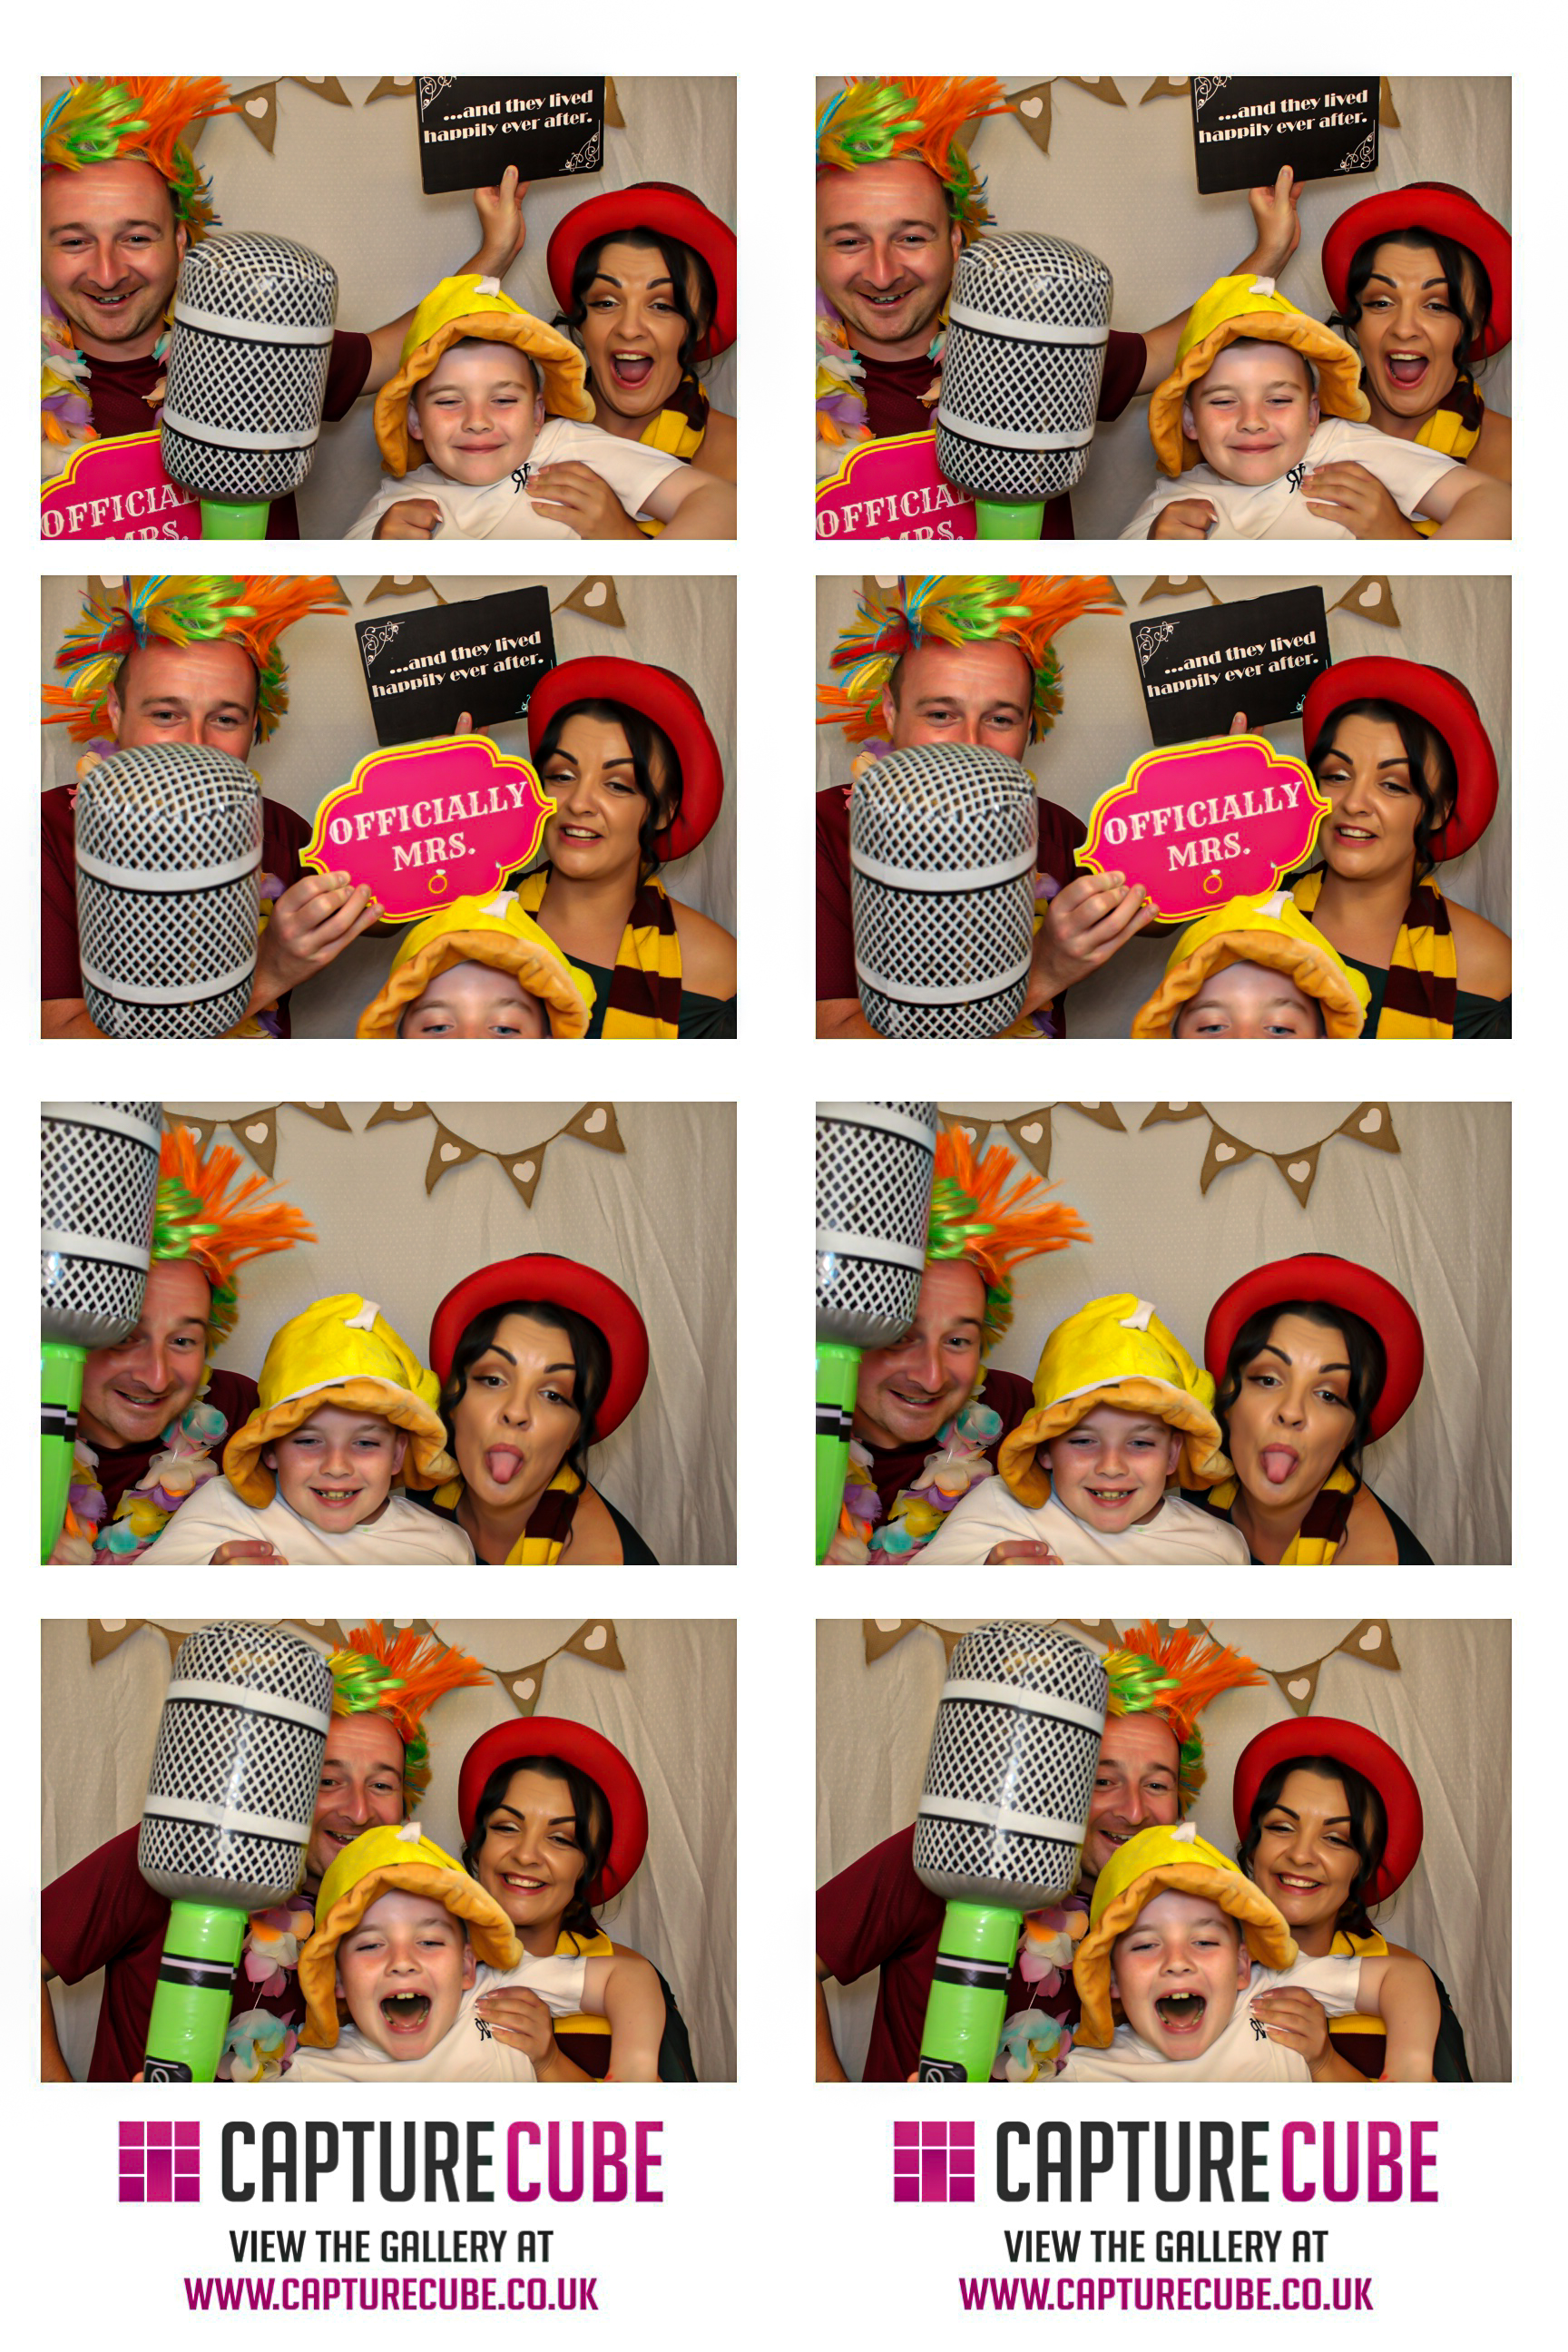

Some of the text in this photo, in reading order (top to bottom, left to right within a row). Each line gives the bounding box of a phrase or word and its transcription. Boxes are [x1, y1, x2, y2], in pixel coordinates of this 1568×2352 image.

[505, 97, 546, 113] they
[549, 89, 593, 108] lived
[1280, 97, 1321, 113] they
[1324, 89, 1368, 108] lived
[423, 112, 593, 144] happily ever after.
[1198, 112, 1367, 144] happily ever after.
[451, 642, 492, 662] they
[495, 631, 542, 652] lived
[1226, 642, 1267, 662] they
[1269, 631, 1317, 652] lived
[371, 652, 544, 698] happily ever after.
[1146, 652, 1319, 698] happily ever after.
[328, 781, 528, 845] OFFICIALLY
[1103, 781, 1303, 845] OFFICIALLY
[392, 832, 475, 871] MRS.
[1167, 832, 1250, 871] MRS.
